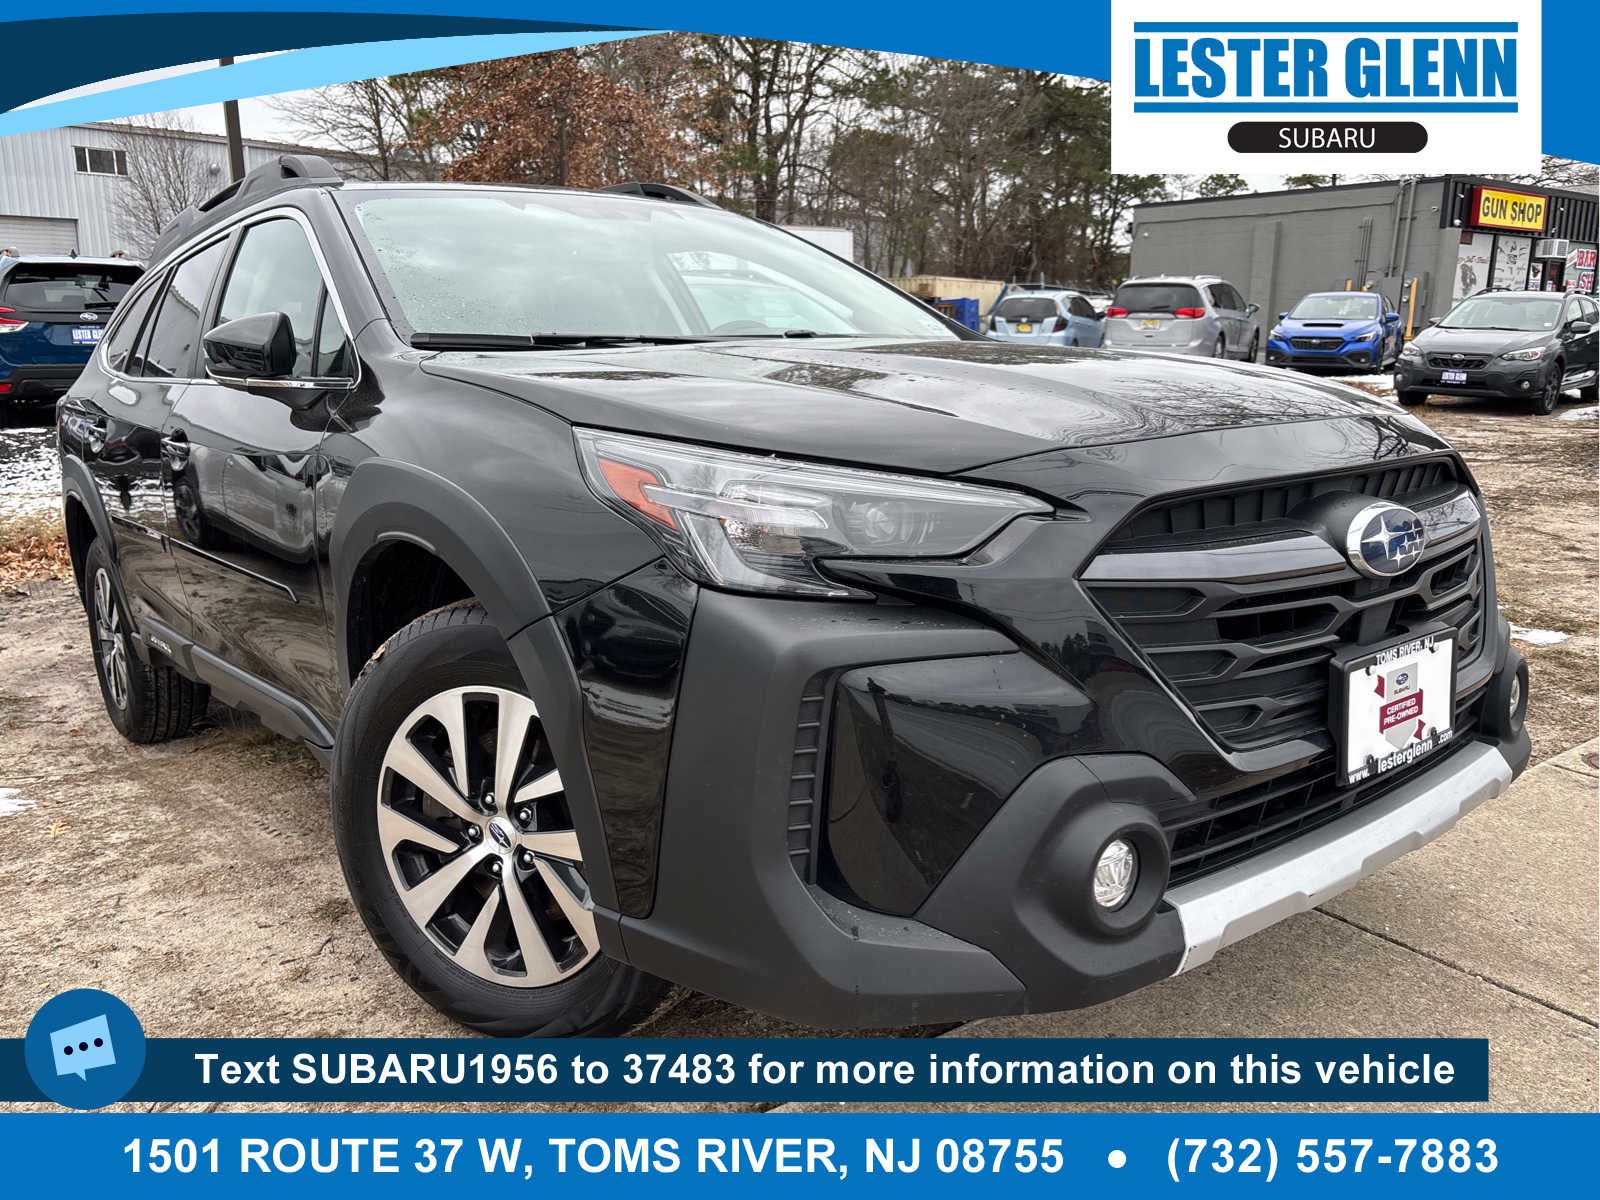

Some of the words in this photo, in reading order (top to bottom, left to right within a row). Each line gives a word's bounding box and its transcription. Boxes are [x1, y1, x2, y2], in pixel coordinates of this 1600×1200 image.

[1482, 196, 1508, 220] GUN
[1510, 200, 1543, 223] SHOP
[1376, 648, 1399, 666] TOMS
[1424, 635, 1435, 650] NJ
[1383, 705, 1419, 726] PRE-OWNED
[1386, 697, 1416, 715] CERTIFIED
[1348, 768, 1370, 784] www.
[1377, 740, 1433, 773] lesterglenn
